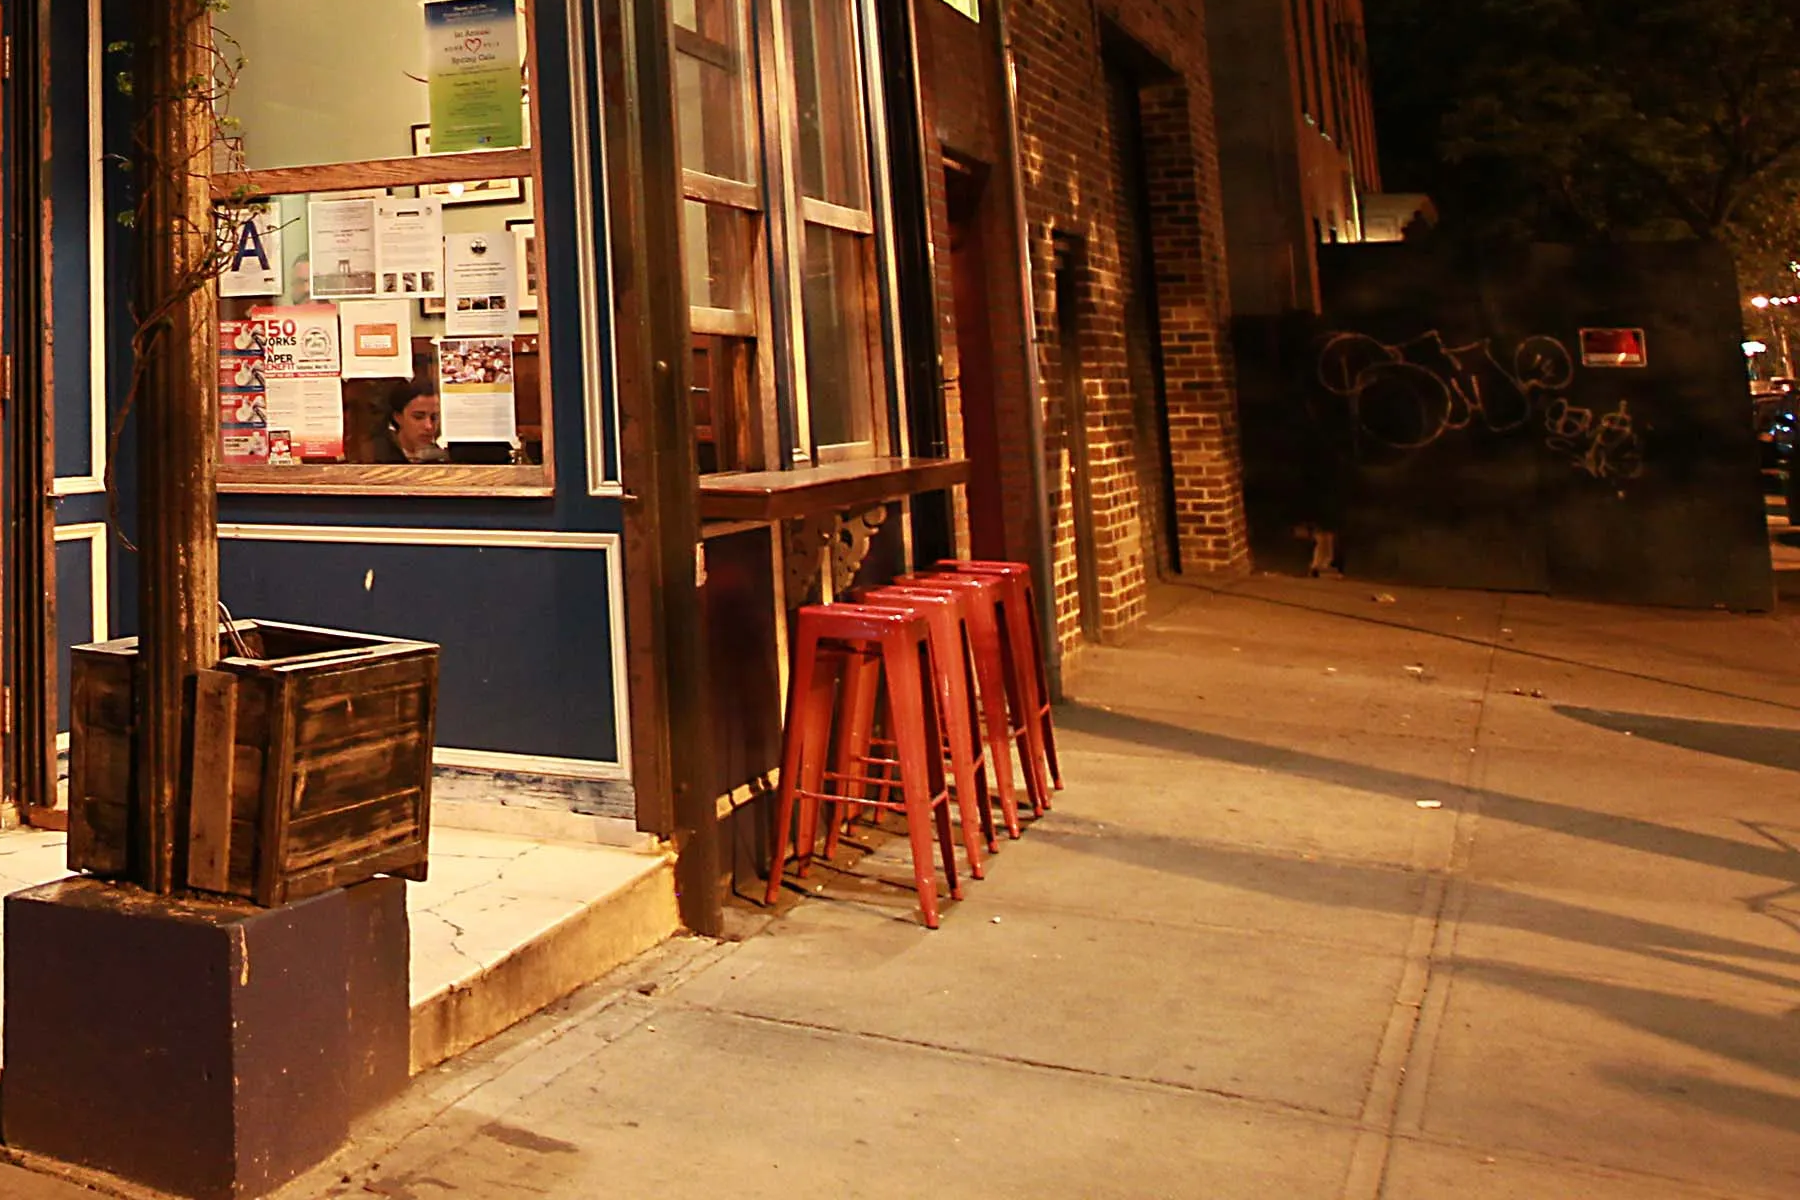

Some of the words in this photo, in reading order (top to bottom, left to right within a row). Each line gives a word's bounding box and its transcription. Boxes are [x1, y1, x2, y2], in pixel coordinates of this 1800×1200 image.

[231, 220, 271, 272] A
[264, 354, 293, 363] APER
[263, 361, 295, 371] ENEFIT
